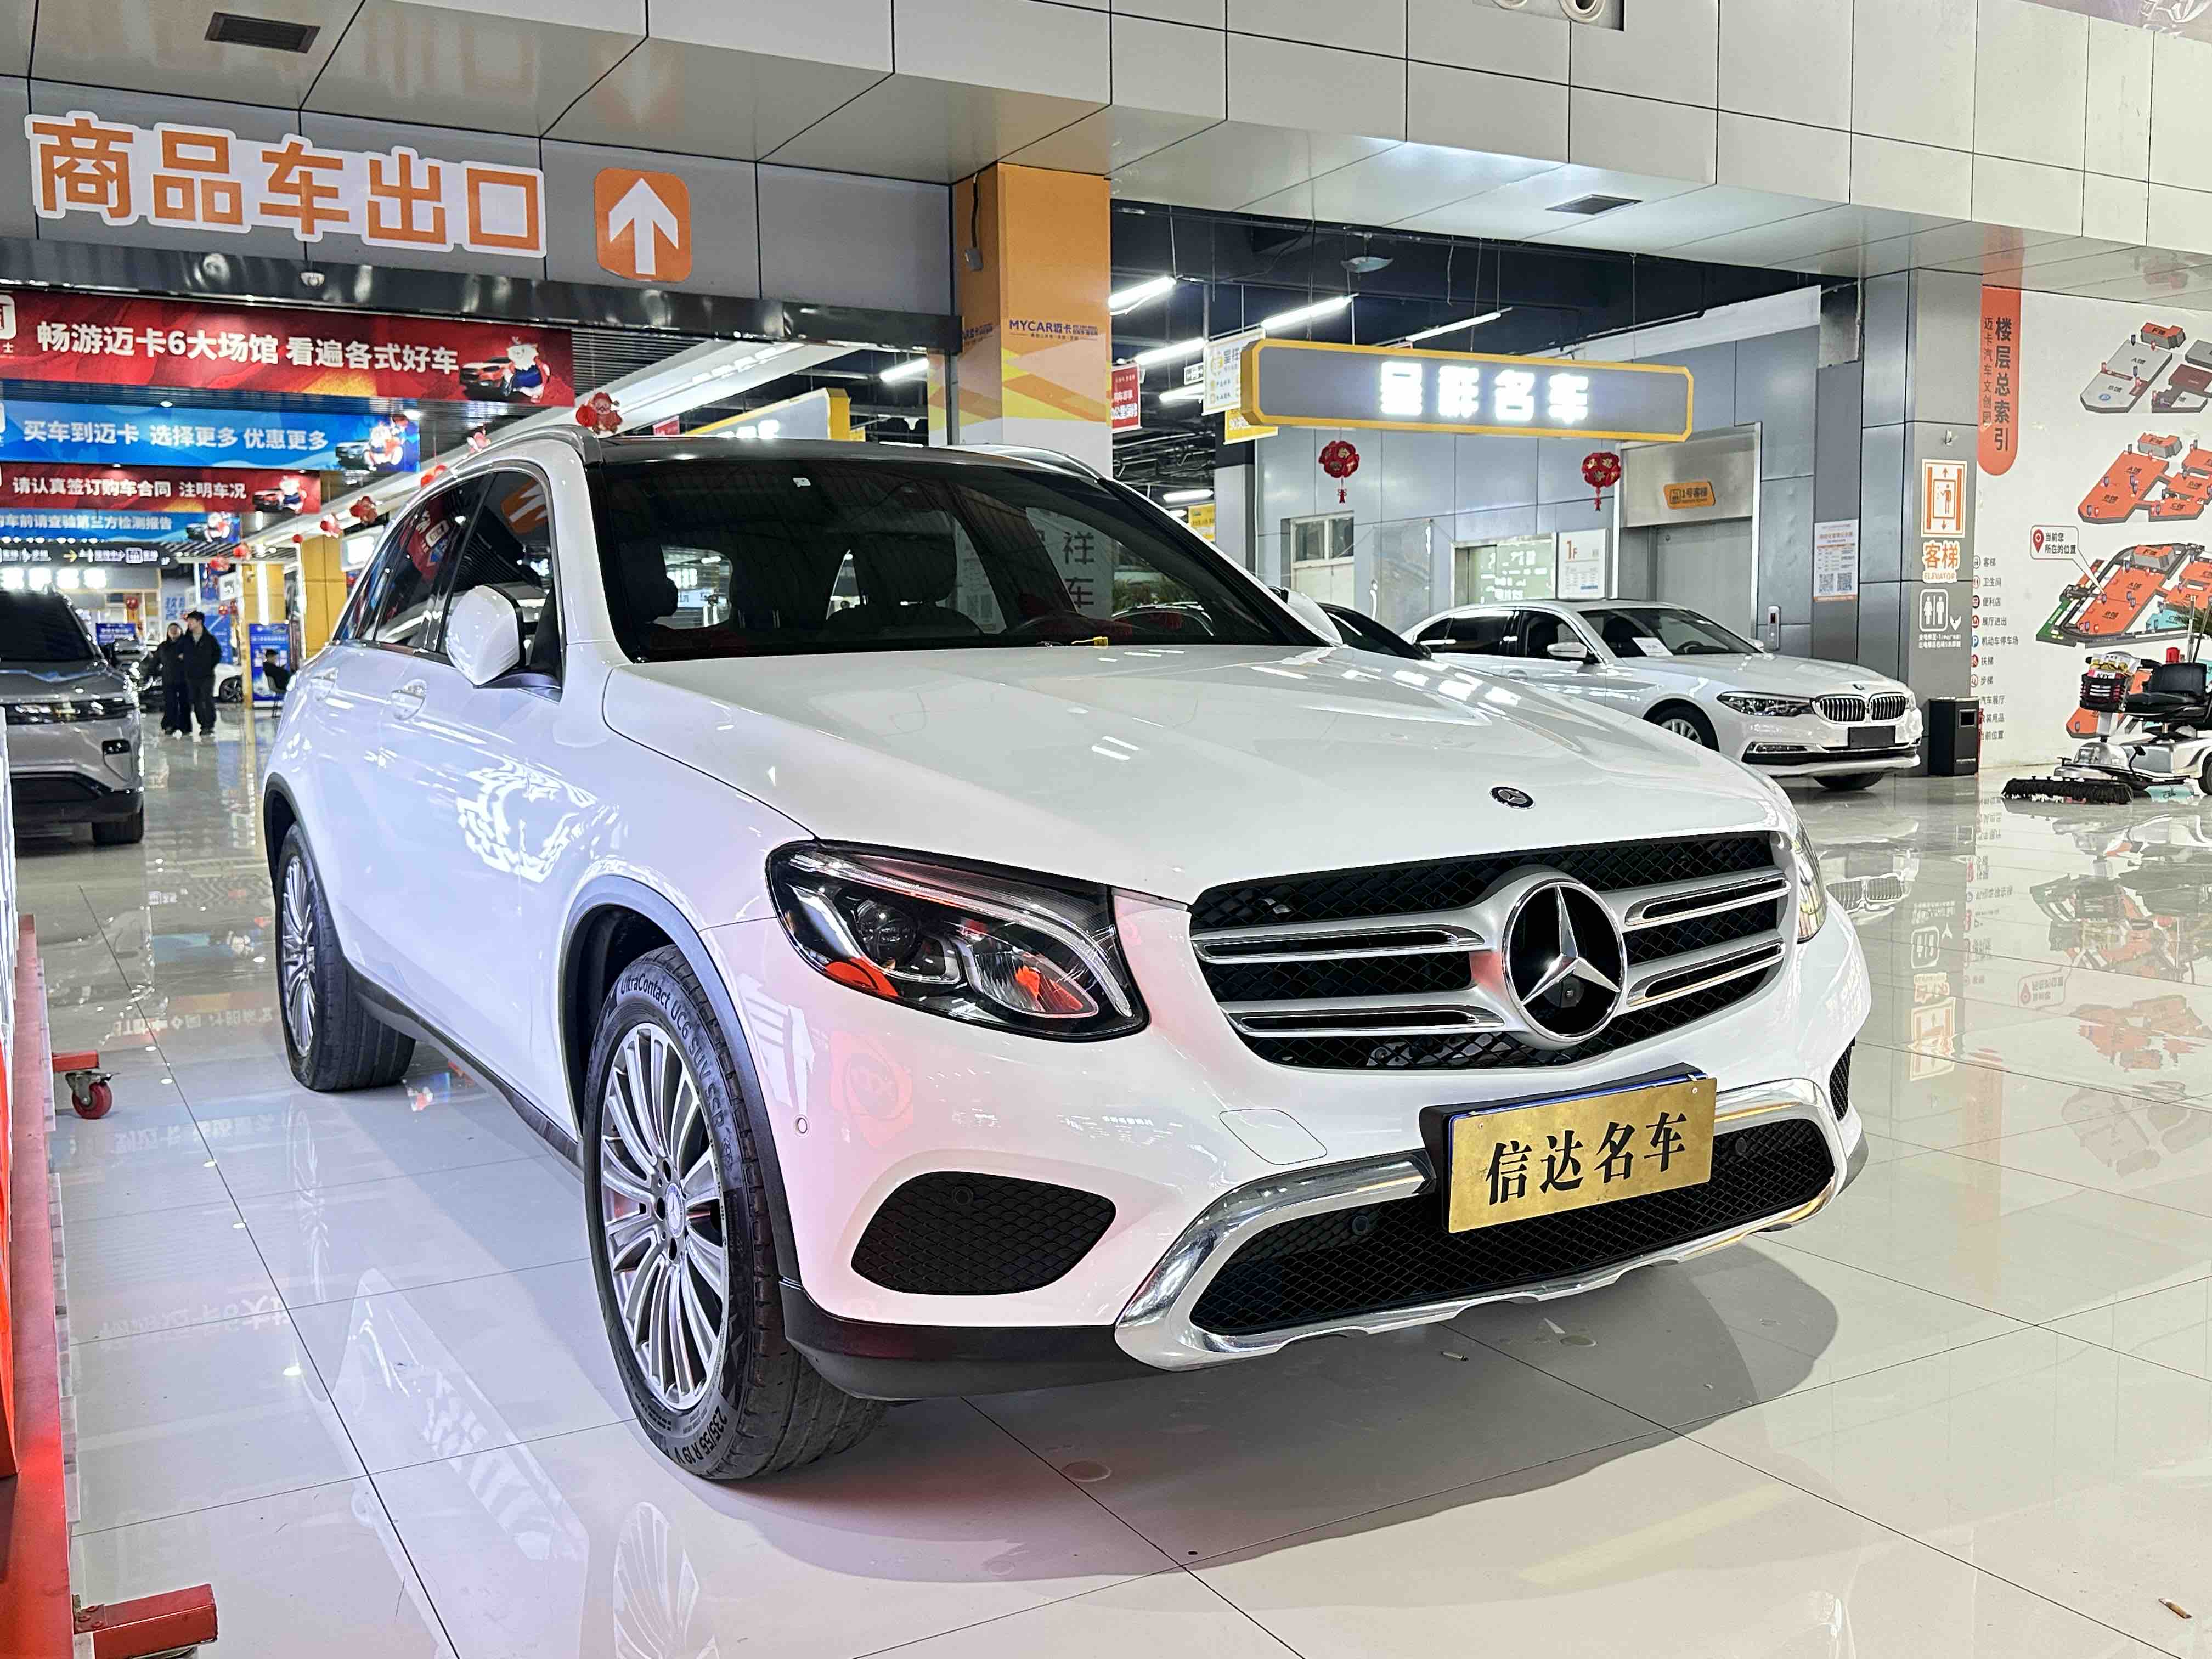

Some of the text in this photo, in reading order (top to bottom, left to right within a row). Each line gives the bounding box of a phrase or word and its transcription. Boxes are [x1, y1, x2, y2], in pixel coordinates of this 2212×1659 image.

[32, 117, 541, 251] 商品车出口
[37, 321, 460, 374] 畅游迈卡6大场馆 看遍各式好车
[1995, 317, 2012, 451] 楼层总索引
[24, 420, 329, 451] 买车到迈卡 选择更多 优惠更多
[13, 476, 247, 500] 请认真签订购车合同 注明车况
[2045, 532, 2064, 543] 当前您
[1566, 540, 1578, 560] 1F
[1925, 543, 1959, 569] 客梯
[2045, 544, 2076, 554] 所在的位置
[1983, 557, 1996, 567] 客梯
[1924, 572, 1955, 580] ELEVATOR
[1983, 578, 2002, 588] 卫生间
[1982, 597, 2001, 607] 便利店
[1982, 617, 2007, 627] 展厅进出
[1982, 636, 2019, 646] 机动车停车场
[1981, 656, 1994, 665] 扶梯
[1980, 675, 1993, 685] 步梯
[620, 973, 671, 1010] UltraContact
[671, 1000, 692, 1040] UC6
[689, 1036, 712, 1081] SUV
[1485, 1111, 1687, 1206] 信达名车
[698, 1405, 728, 1452] 235/55
